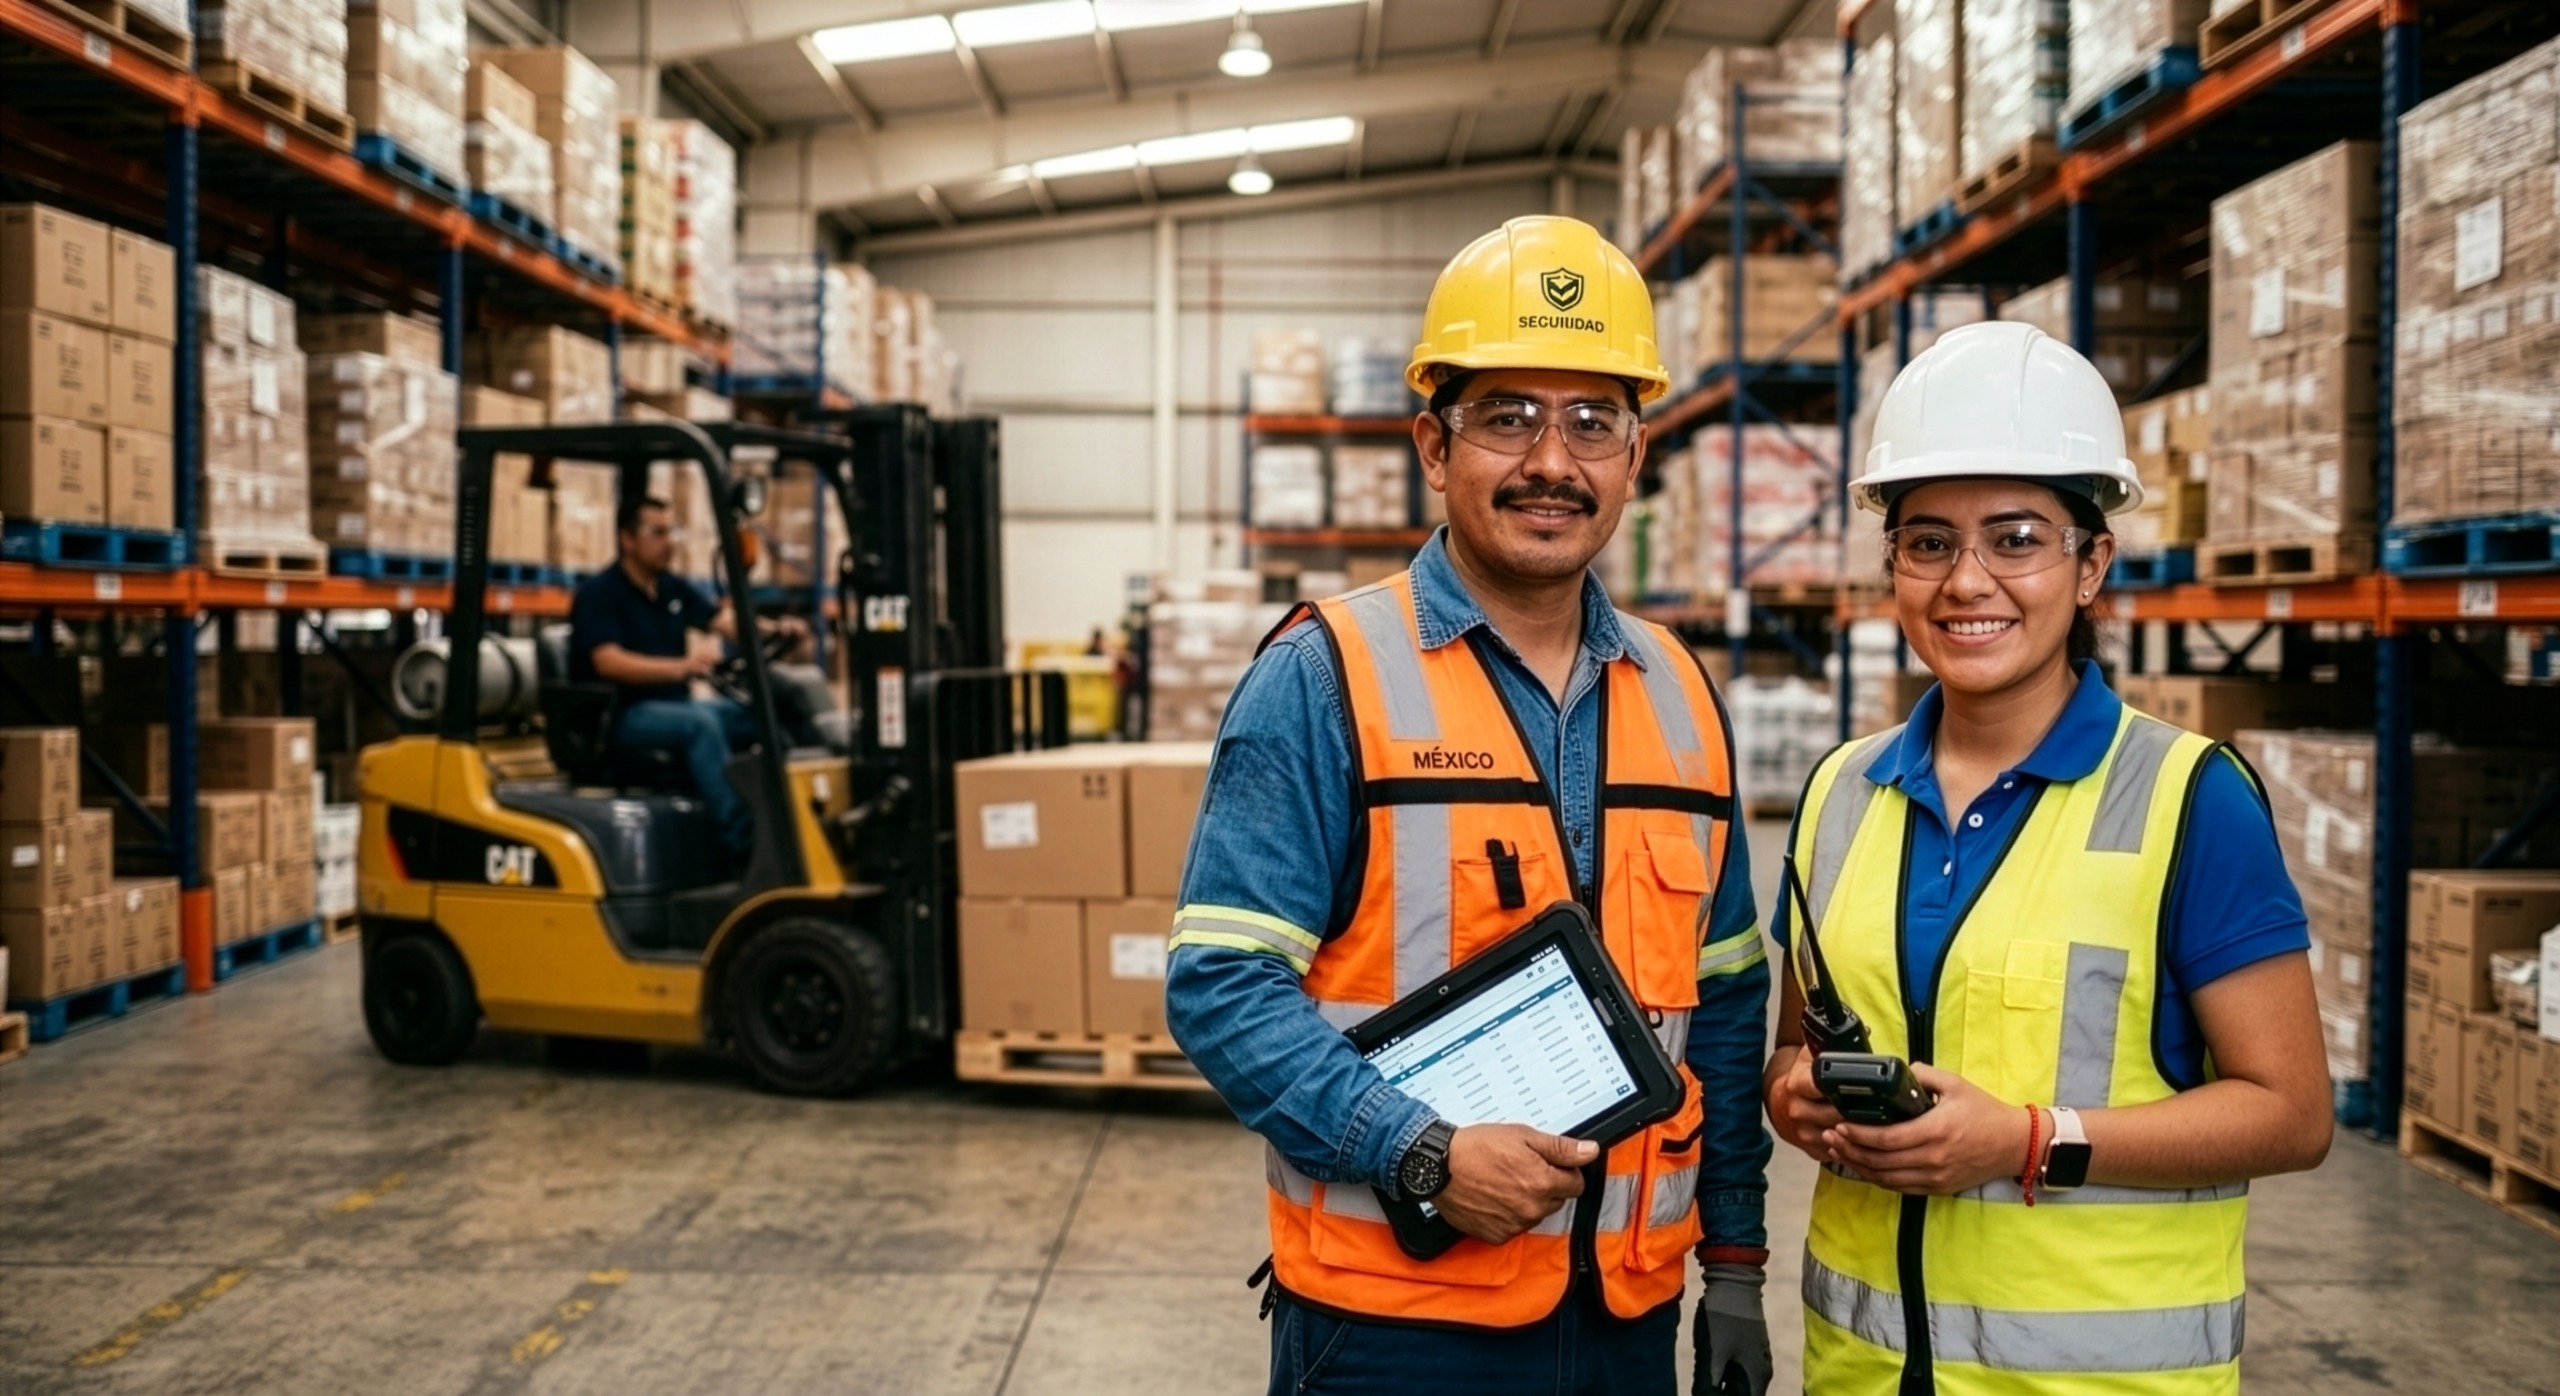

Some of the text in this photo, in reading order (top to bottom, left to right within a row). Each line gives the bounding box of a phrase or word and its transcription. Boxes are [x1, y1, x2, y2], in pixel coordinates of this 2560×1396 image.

[864, 595, 910, 632] CAT
[1413, 746, 1494, 769] MÉXICO
[485, 844, 536, 886] CAT
